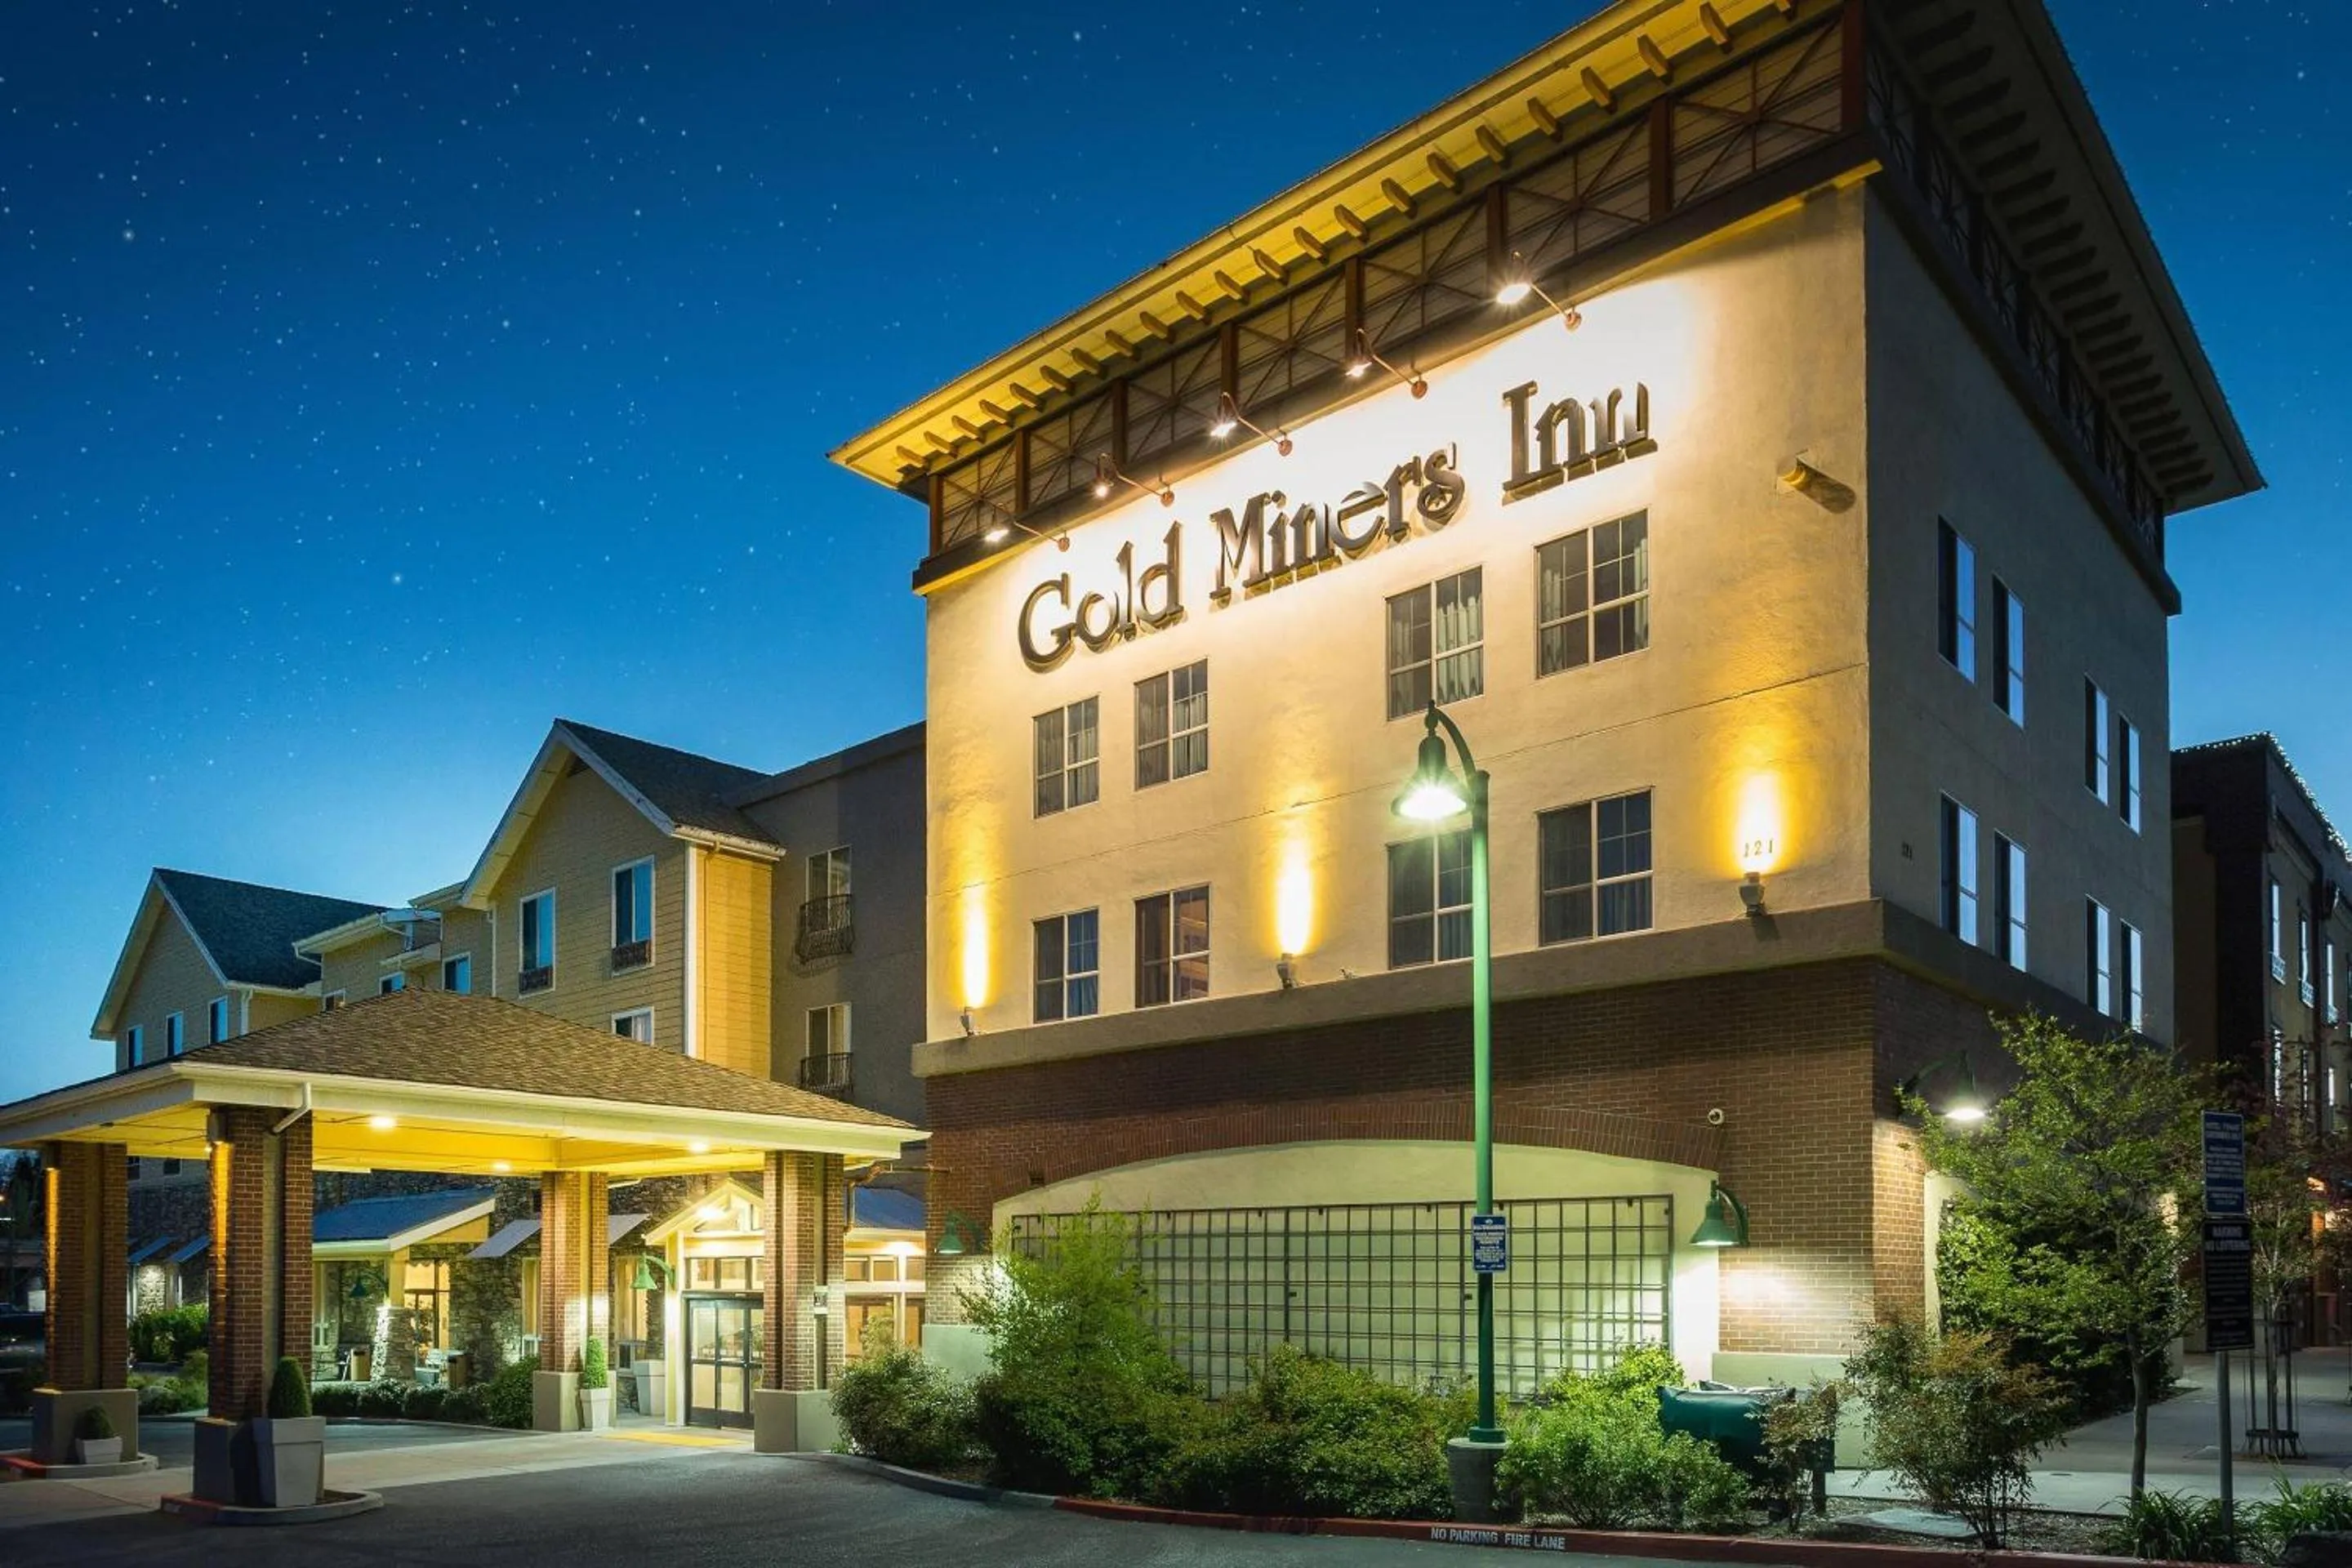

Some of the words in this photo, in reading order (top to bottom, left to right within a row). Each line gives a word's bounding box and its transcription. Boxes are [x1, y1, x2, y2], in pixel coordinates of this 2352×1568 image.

[1018, 520, 1185, 665] Gold
[1209, 442, 1465, 600] Miners
[1502, 381, 1649, 492] Inn
[1744, 839, 1773, 858] 121
[1431, 1526, 1447, 1540] NO
[1450, 1529, 1499, 1544] PARKING
[1504, 1532, 1531, 1547] FIRE
[1534, 1535, 1566, 1550] LANE
